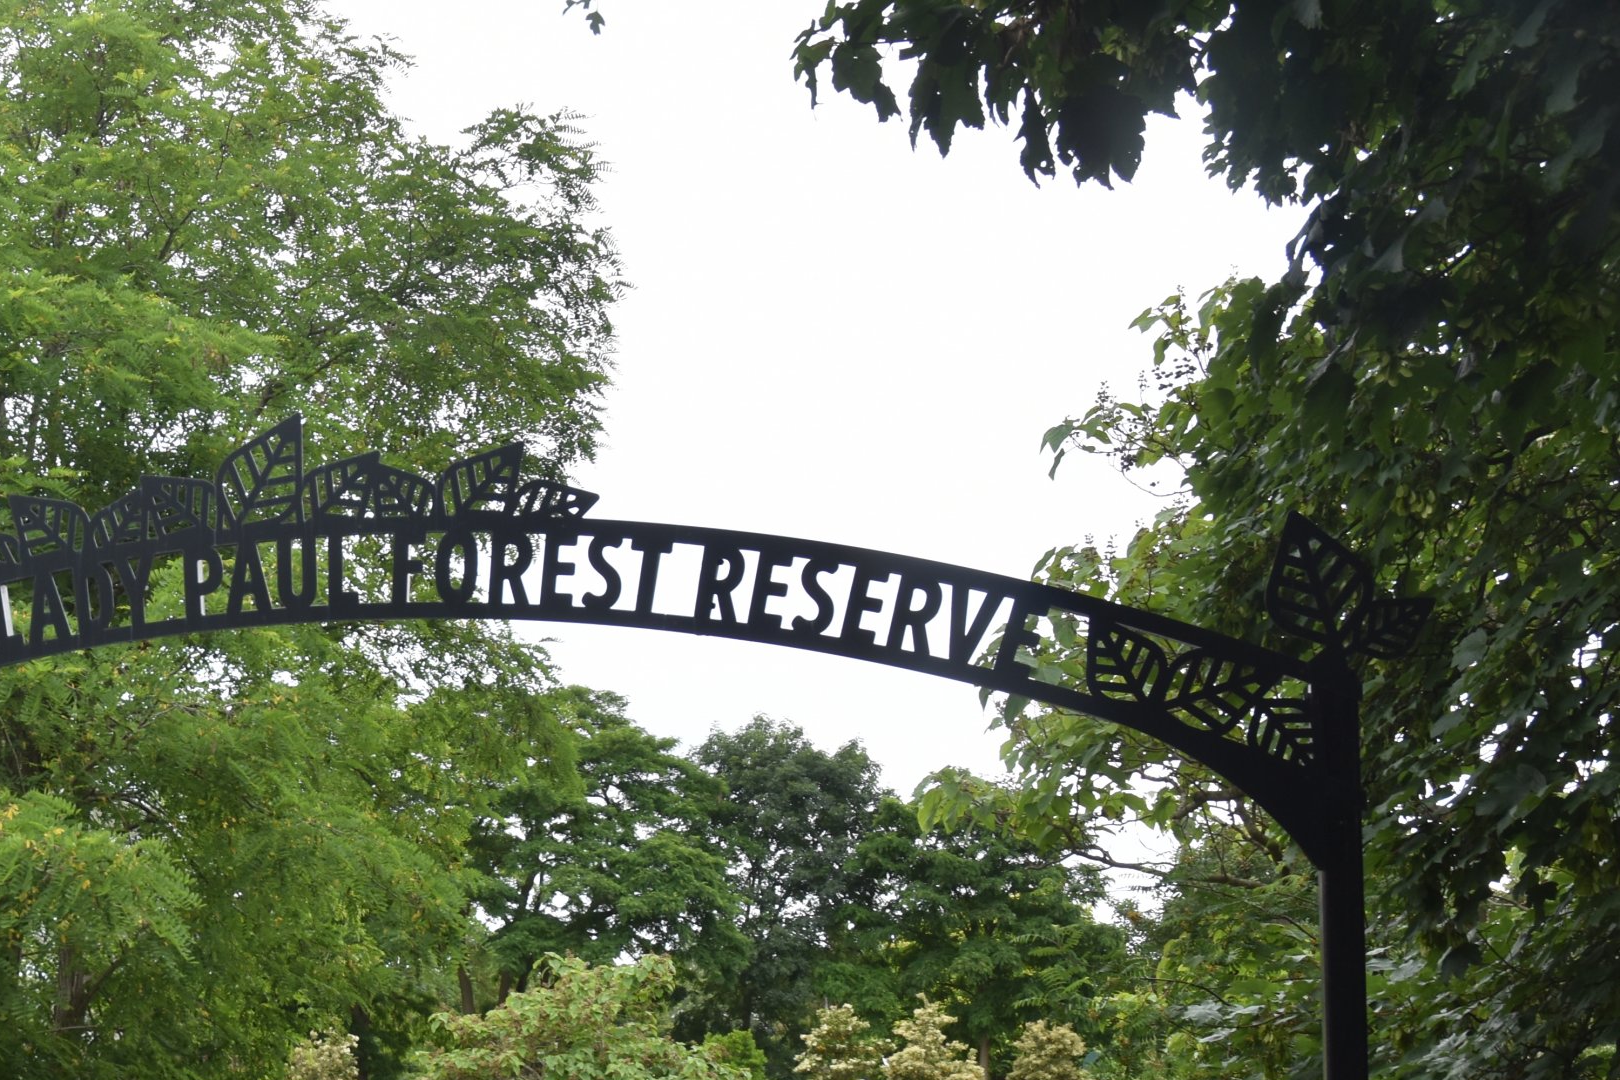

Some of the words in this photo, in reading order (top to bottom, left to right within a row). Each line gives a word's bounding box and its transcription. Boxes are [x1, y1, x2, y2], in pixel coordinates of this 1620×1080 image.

[184, 534, 359, 619] PAUL
[392, 531, 674, 613] FOREST
[694, 545, 1049, 679] RESERVE
